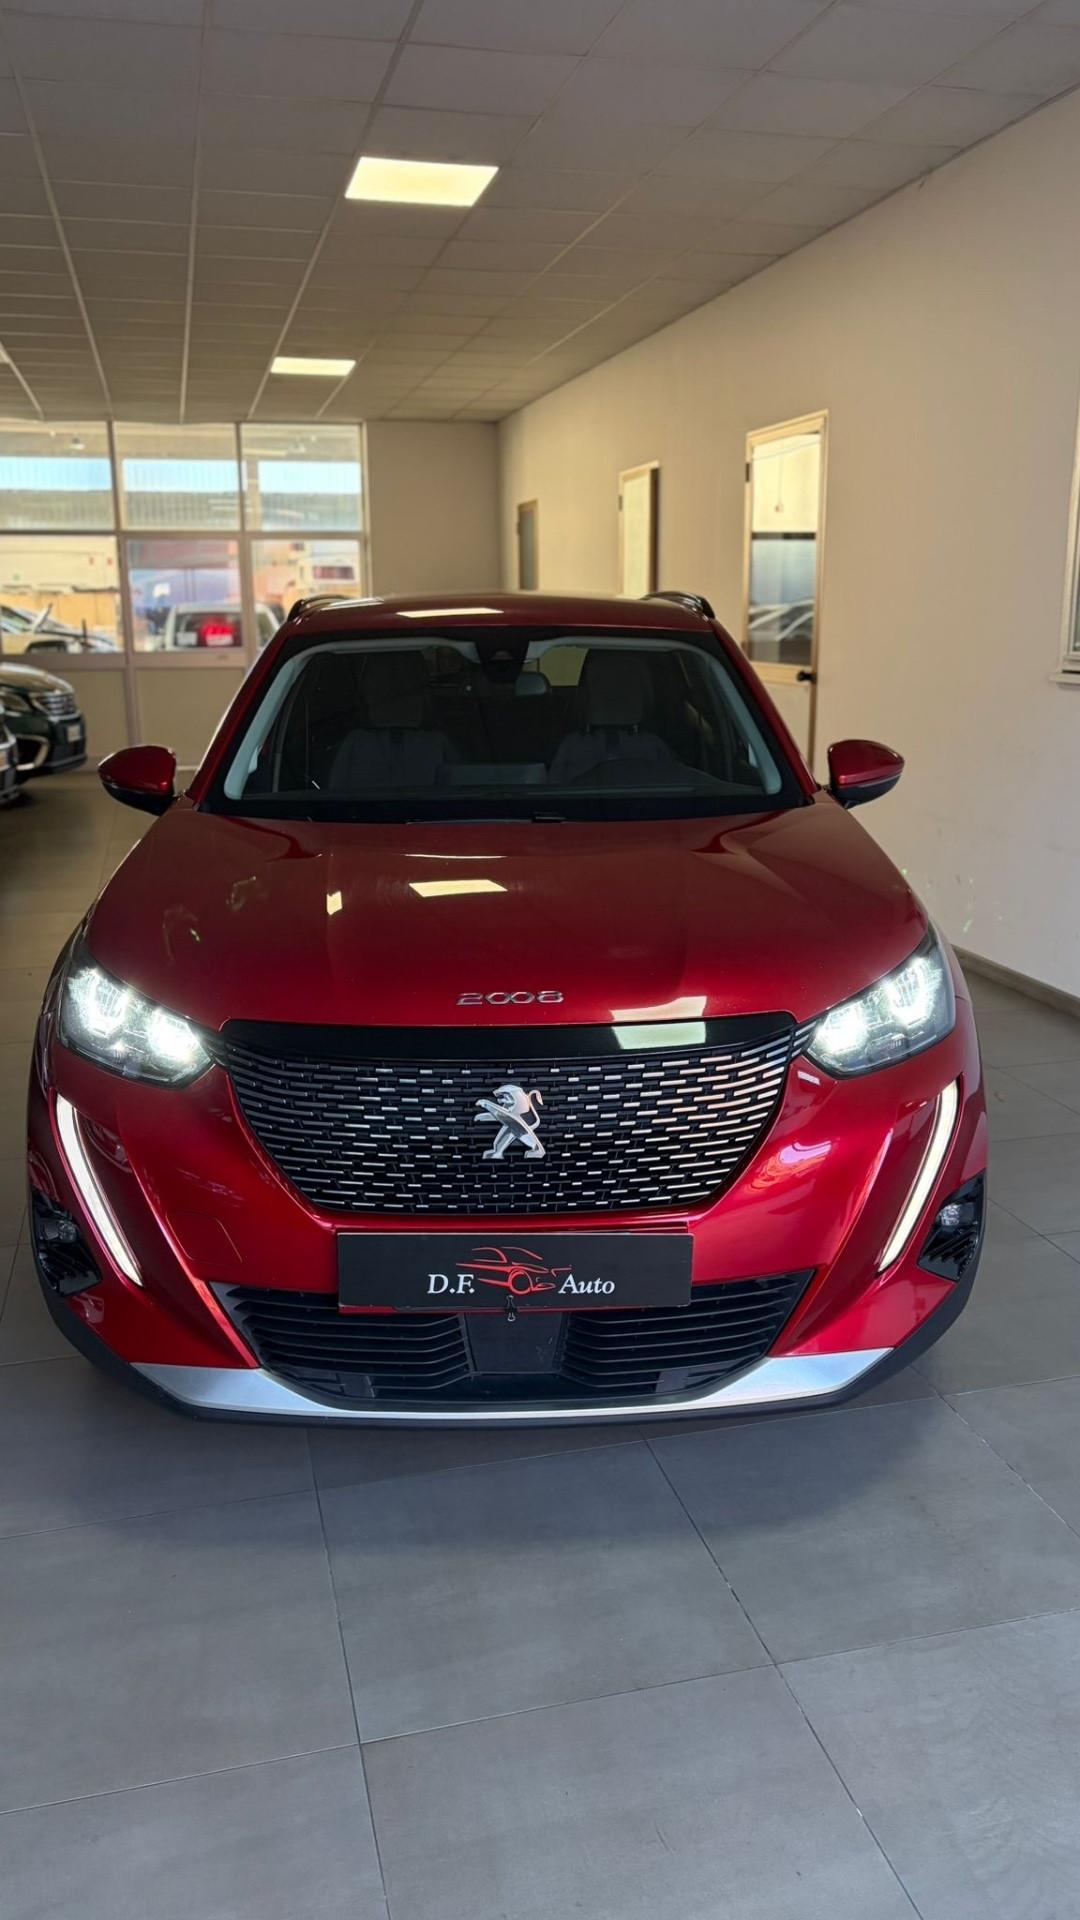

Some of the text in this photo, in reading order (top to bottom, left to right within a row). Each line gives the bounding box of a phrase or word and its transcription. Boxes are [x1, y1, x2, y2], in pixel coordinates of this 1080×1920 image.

[456, 990, 564, 1005] 2008
[427, 1273, 616, 1294] D.F. Auto
